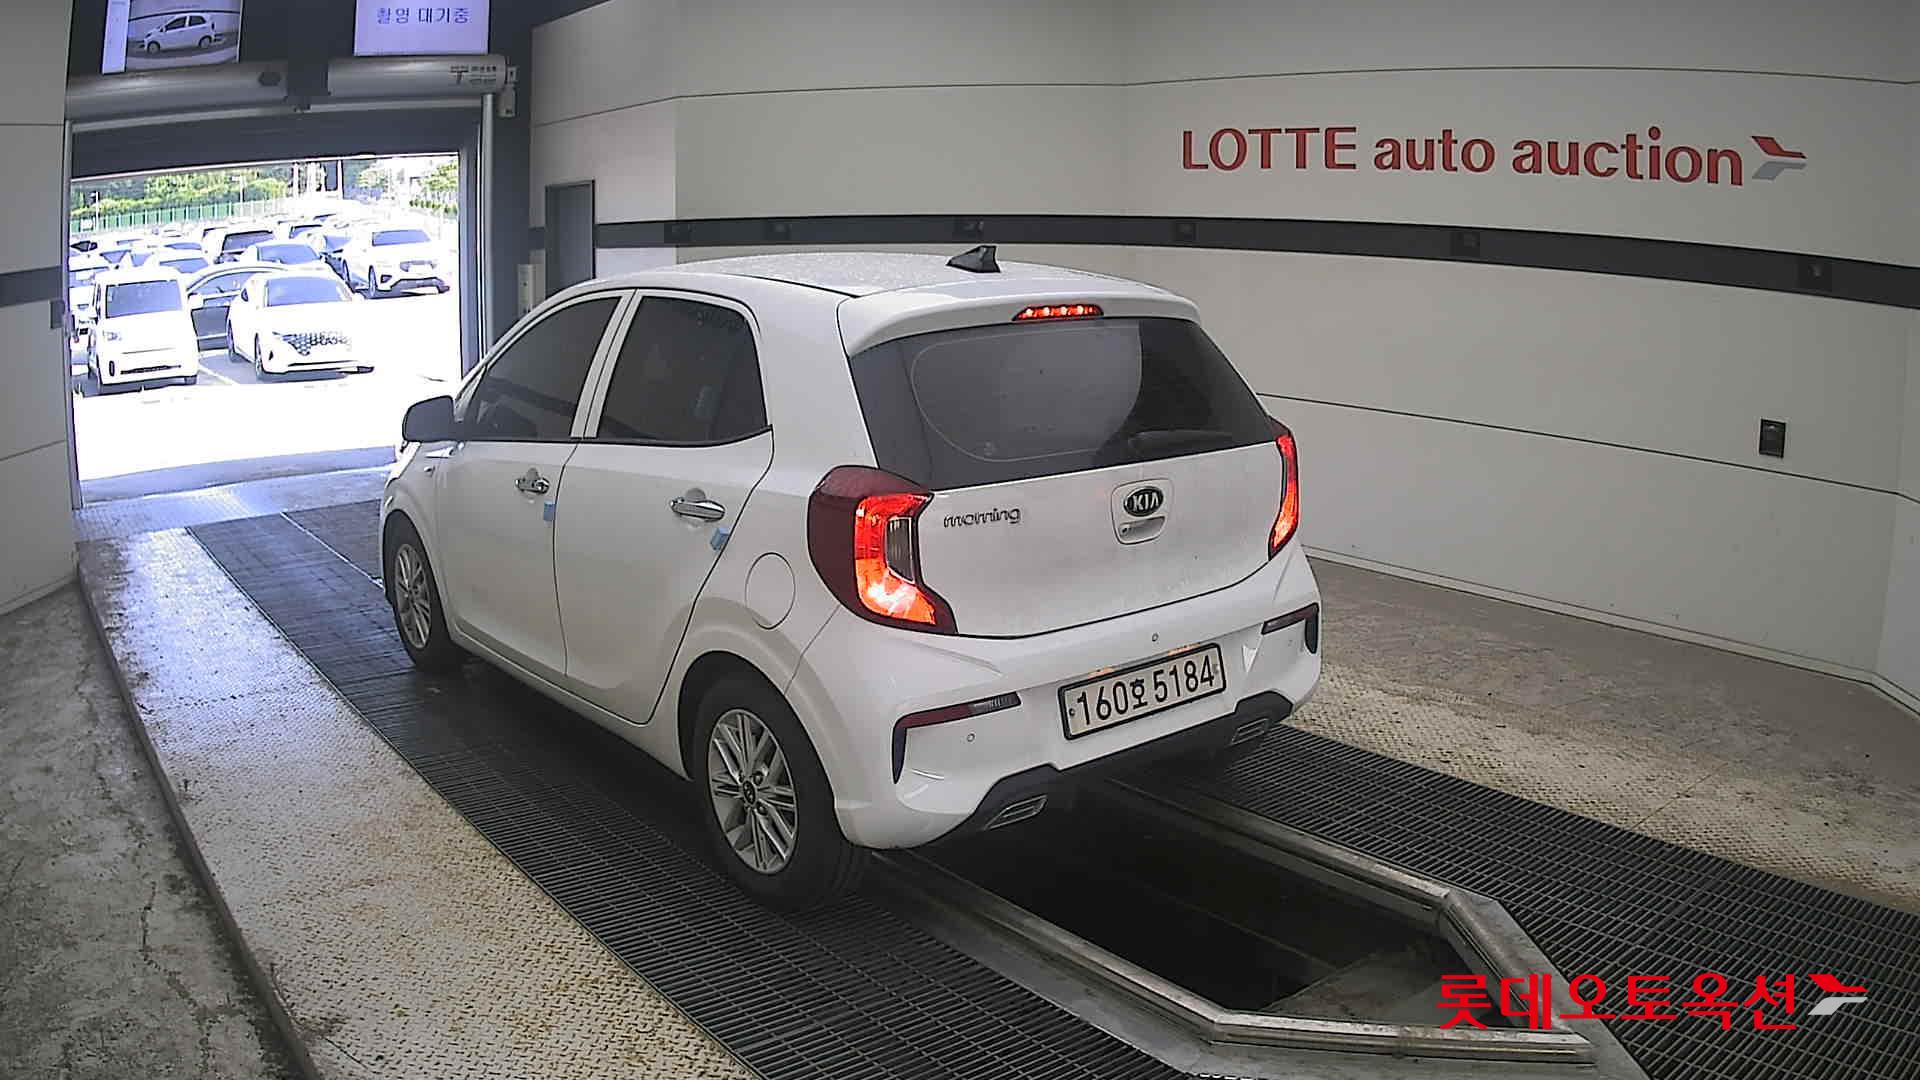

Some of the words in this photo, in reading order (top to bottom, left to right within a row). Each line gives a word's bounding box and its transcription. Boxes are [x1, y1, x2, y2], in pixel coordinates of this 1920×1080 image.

[418, 7, 470, 24] 대기중
[1182, 126, 1357, 171] LOTTE
[1373, 128, 1496, 173] auto
[1511, 126, 1743, 186] auction
[1132, 492, 1159, 512] KIA
[943, 507, 1021, 528] morning
